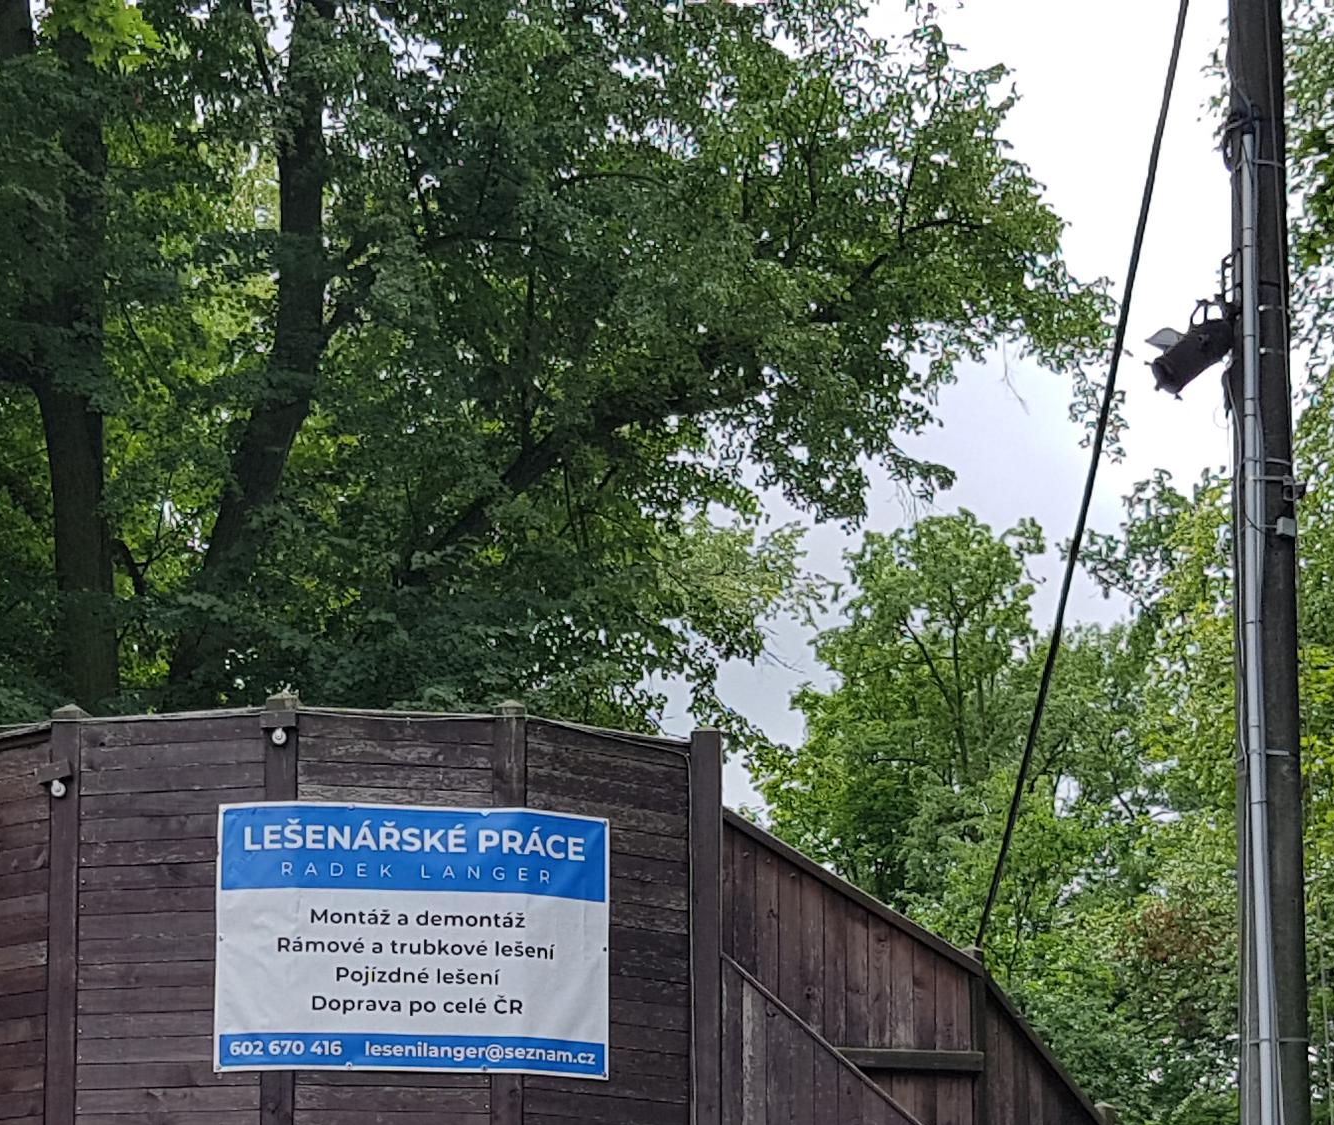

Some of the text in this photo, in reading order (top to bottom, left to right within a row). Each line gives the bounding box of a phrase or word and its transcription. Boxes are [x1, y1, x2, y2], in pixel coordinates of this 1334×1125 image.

[243, 817, 586, 862] LEŠENÁŘSKÉ PRÁCE
[281, 861, 551, 885] RADEK LANGER
[310, 908, 526, 929] Montáž a demontáž
[277, 936, 555, 960] Rámové a trubkové lešení
[336, 965, 501, 987] Pojízdné lešení
[312, 994, 524, 1017] Doprava po celé ČR
[229, 1039, 597, 1065] 602 670 416 lesenilanger@seznam.cz
